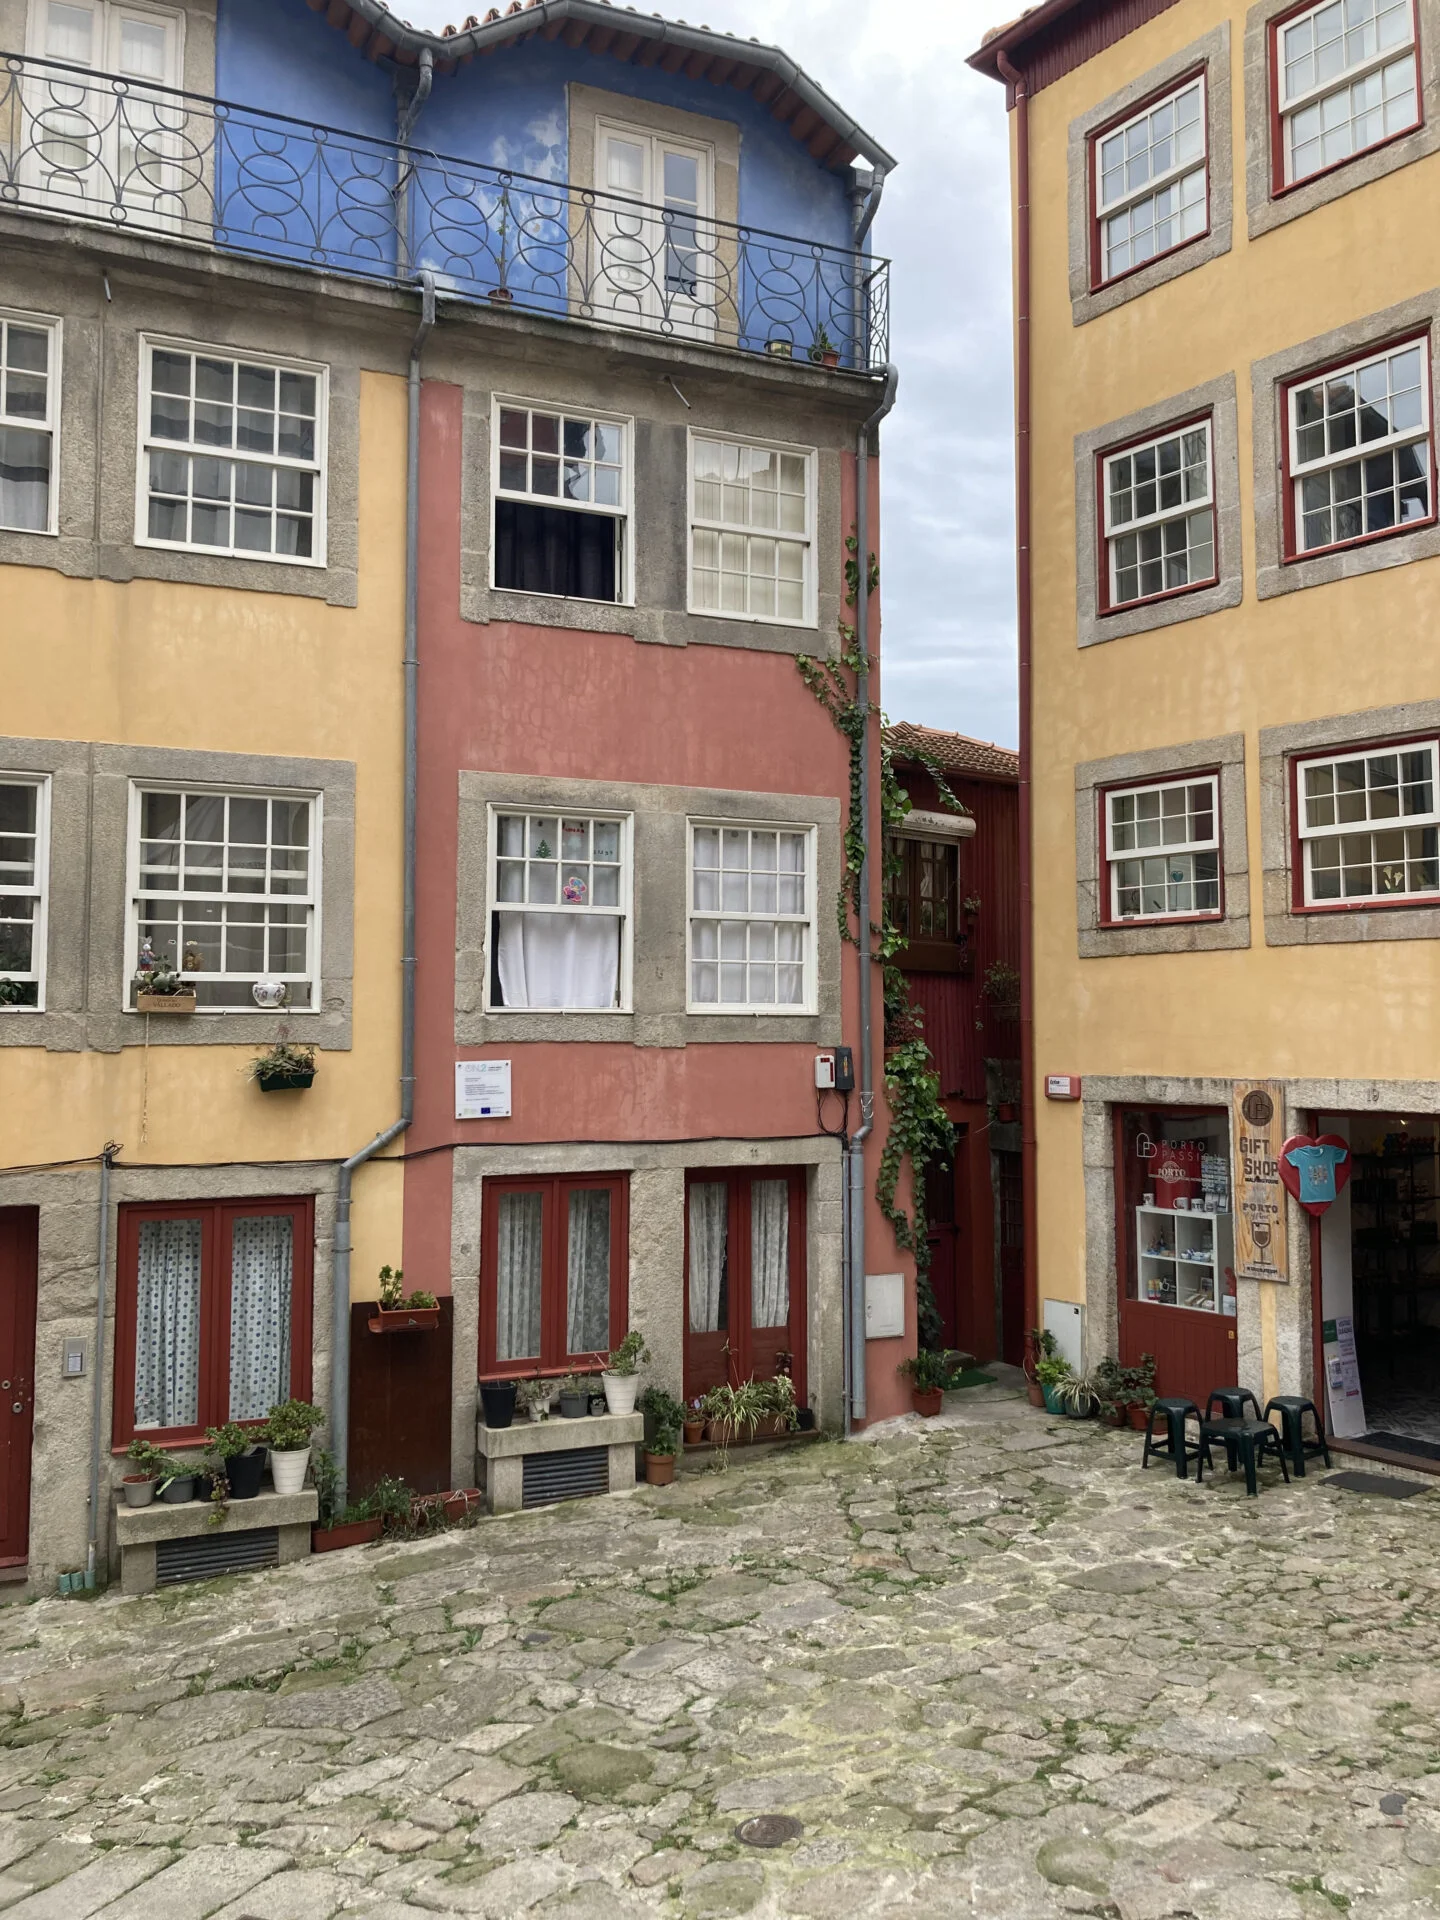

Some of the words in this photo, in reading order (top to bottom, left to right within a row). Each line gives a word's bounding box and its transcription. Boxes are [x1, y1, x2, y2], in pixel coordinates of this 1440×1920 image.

[1366, 1088, 1380, 1102] 19
[1161, 1139, 1205, 1152] PORTO
[1239, 1136, 1270, 1154] GIFT
[1244, 1157, 1279, 1176] SHOP
[1242, 1202, 1278, 1214] PORTO
